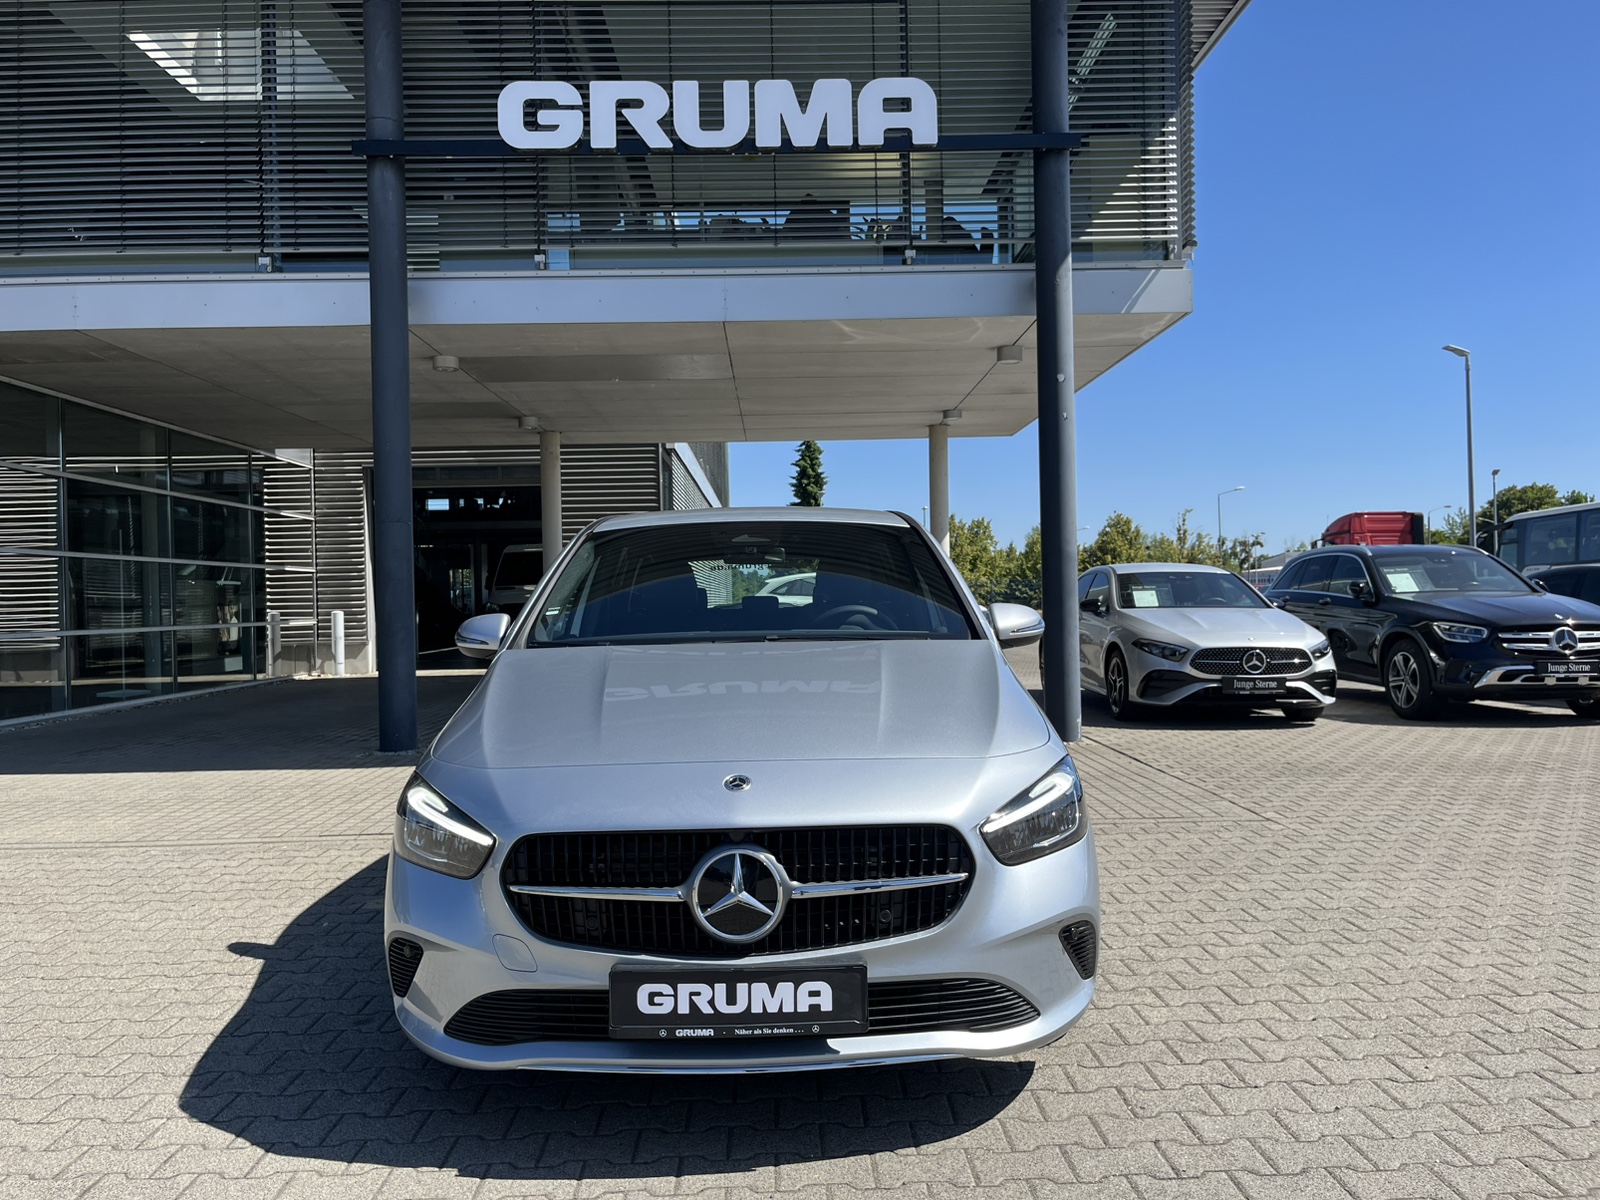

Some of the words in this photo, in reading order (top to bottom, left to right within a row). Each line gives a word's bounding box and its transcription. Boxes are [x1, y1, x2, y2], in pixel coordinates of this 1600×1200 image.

[498, 78, 937, 149] GRUMA
[1547, 662, 1568, 673] Junge
[1568, 662, 1591, 671] Sterne
[1233, 679, 1254, 690] Junge
[1255, 679, 1277, 688] Sterne
[636, 981, 833, 1015] GRUMA
[675, 1028, 714, 1037] GRUMA
[734, 1028, 753, 1036] Näher
